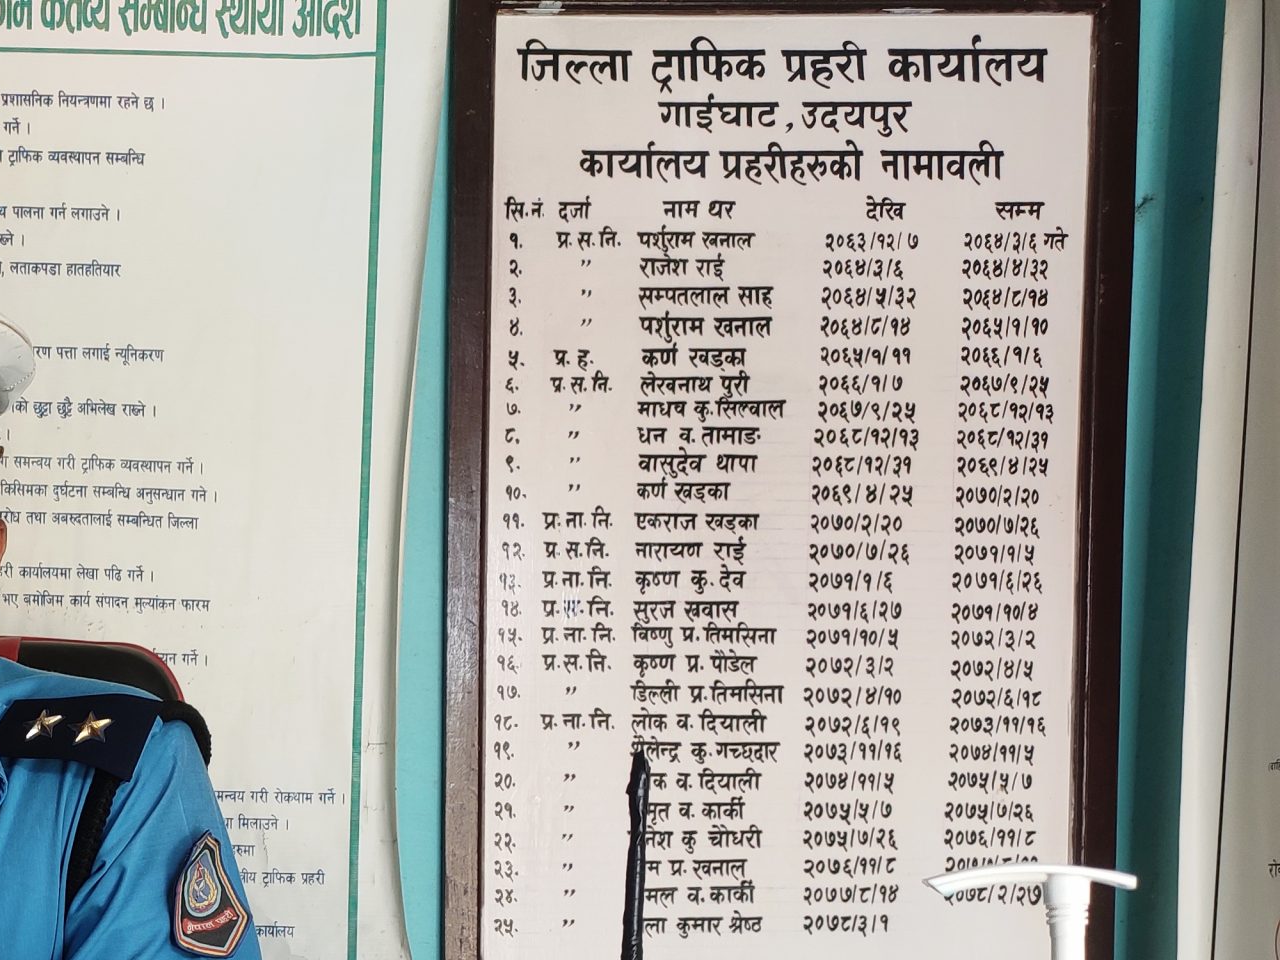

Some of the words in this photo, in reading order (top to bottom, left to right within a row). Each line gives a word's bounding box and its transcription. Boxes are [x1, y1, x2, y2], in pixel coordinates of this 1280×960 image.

[516, 39, 632, 84] जिल्ला
[652, 36, 766, 93] ट्राफिक
[781, 41, 867, 89] प्रहरी
[888, 35, 1048, 86] कार्यालय
[1, 90, 54, 107] प्रशासनिक
[58, 90, 112, 108] नियन्त्रणमा
[116, 92, 140, 109] रहने
[3, 117, 21, 135] गर्ने
[580, 141, 710, 183] कार्यालय
[880, 140, 1004, 185] नामावली
[558, 195, 592, 223] दर्जा
[662, 200, 700, 218] नाम
[708, 200, 736, 219] थर
[866, 195, 906, 221] देखि
[995, 202, 1045, 220] सम्म
[702, 232, 756, 250] खनाल
[964, 232, 1037, 254] २०६४/३/६
[1044, 226, 1069, 251] गते
[10, 262, 62, 276] लताकपडा
[640, 254, 690, 279] राजेश
[695, 253, 725, 281] राई
[823, 258, 903, 280] २०६४/३/६
[962, 257, 1048, 281] २०६४/४/३२
[638, 287, 730, 310] सम्पतलाल
[738, 286, 774, 309] साह
[963, 287, 1048, 310] २०६४/८/१४
[714, 316, 773, 338] खनाल
[820, 315, 910, 339] २०६४/८/१४
[962, 316, 1048, 340] २०६५/१/१०
[641, 342, 678, 367] कर्ण
[13, 456, 52, 469] समन्वय
[57, 453, 76, 470] गरी
[81, 453, 116, 474] ट्राफिक
[120, 459, 172, 473] व्यवस्थापन
[176, 457, 194, 474] गर्ने
[716, 454, 758, 473] थापा
[635, 542, 703, 561] नारायण
[713, 536, 747, 565] राई
[633, 600, 676, 624] सुरज
[803, 884, 899, 905] २०७७/८/१४
[676, 917, 723, 939] कुमार
[729, 910, 763, 934] श्रेष्ठ
[803, 914, 888, 937] २०७८/३/१
